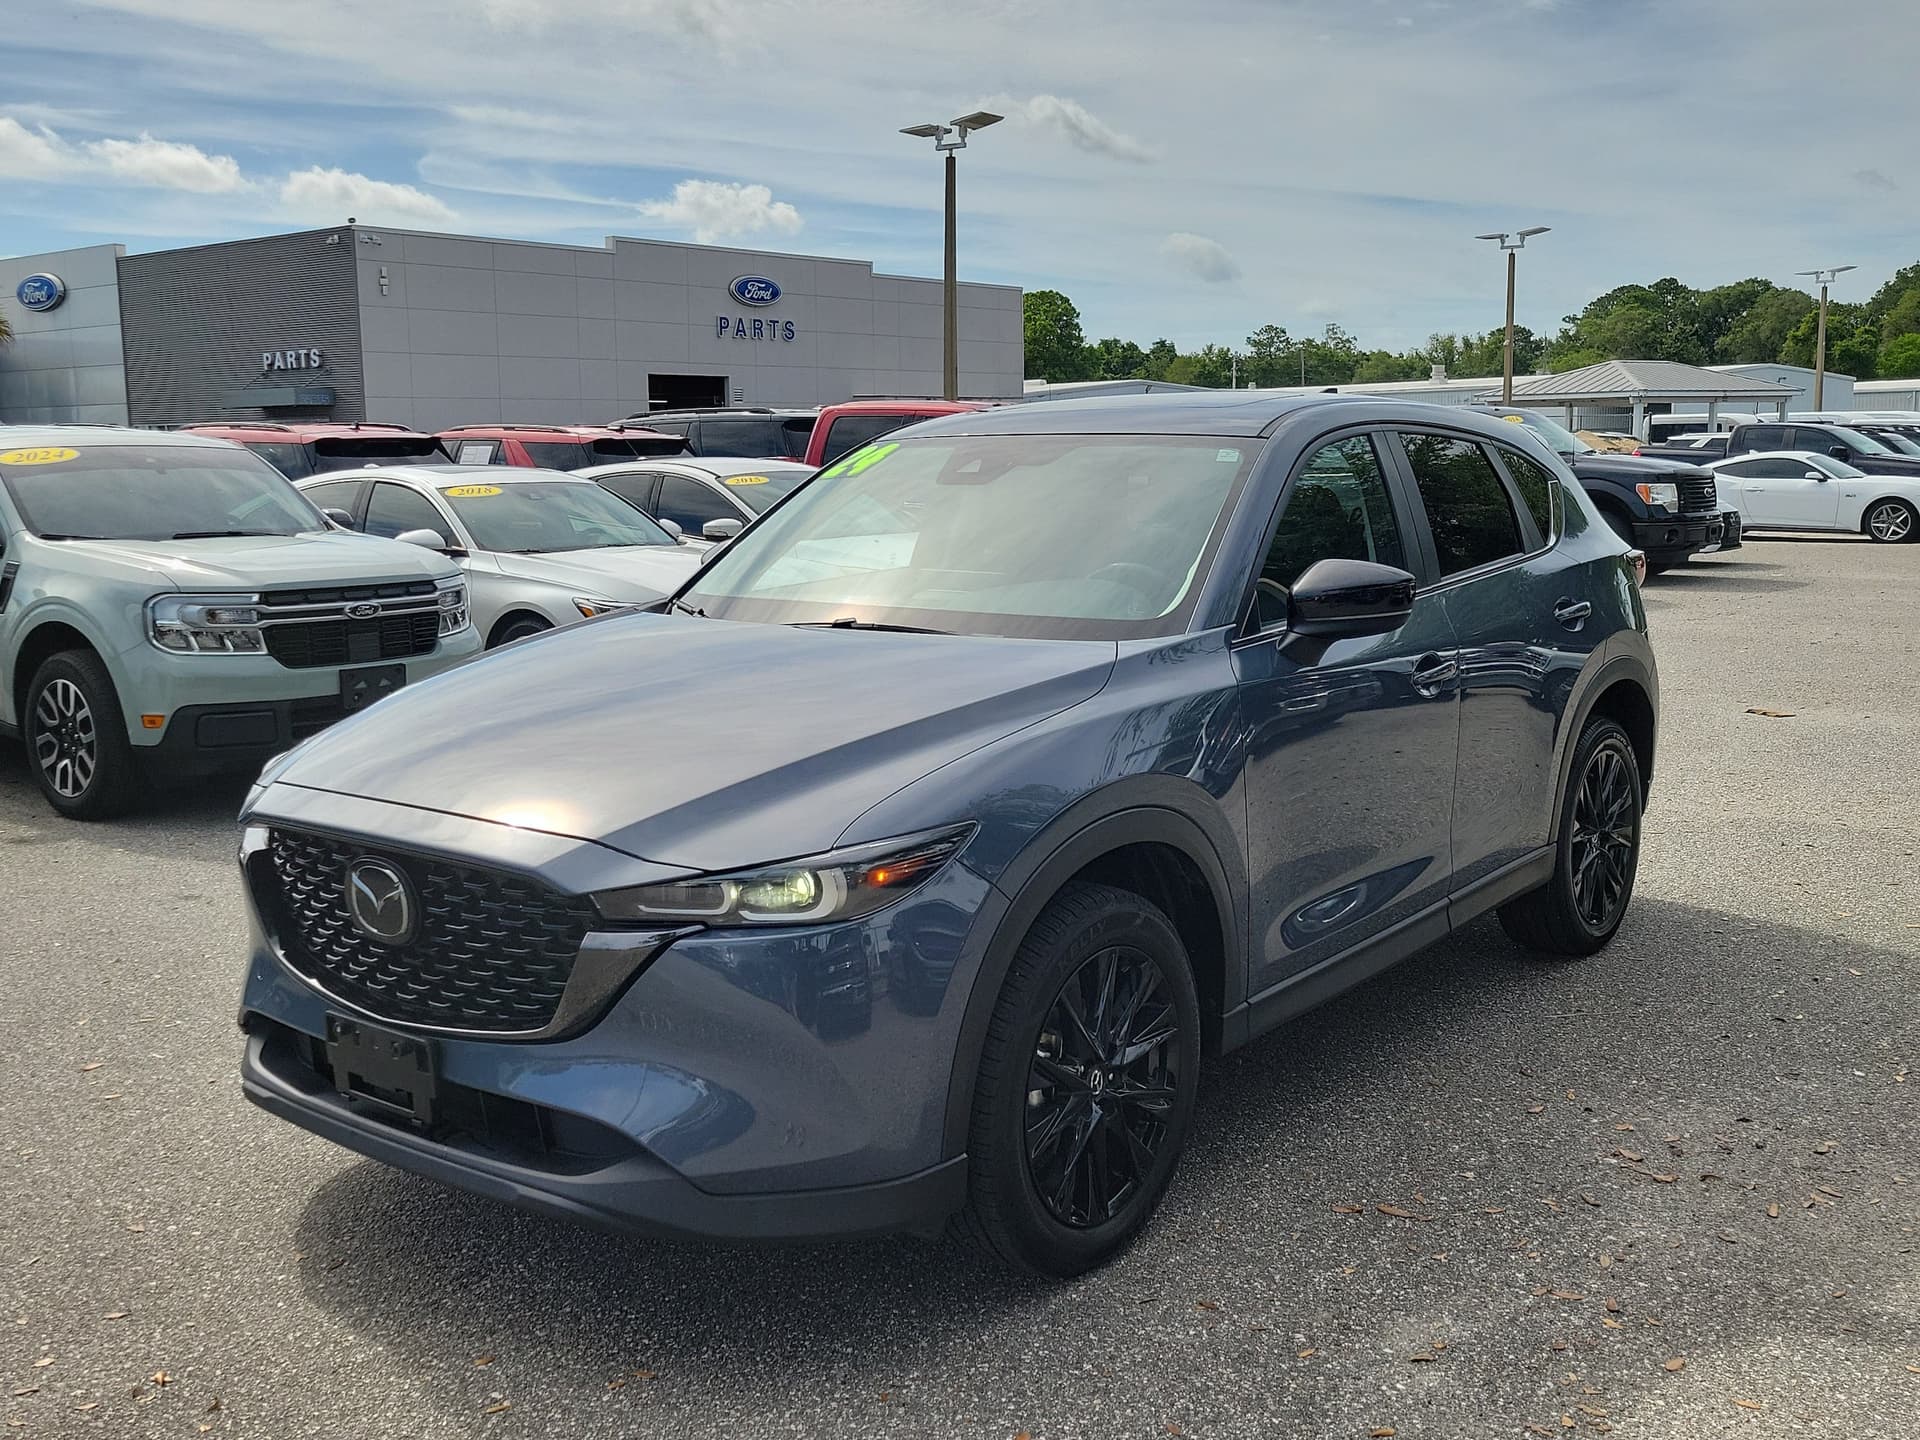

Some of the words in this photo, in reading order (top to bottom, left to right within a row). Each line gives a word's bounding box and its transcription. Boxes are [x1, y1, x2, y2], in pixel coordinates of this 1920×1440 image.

[24, 282, 48, 303] Ford
[744, 281, 773, 300] Ford
[717, 316, 796, 342] PARTS
[263, 348, 320, 370] PARTS
[15, 449, 65, 463] 2024
[457, 487, 493, 496] 2018
